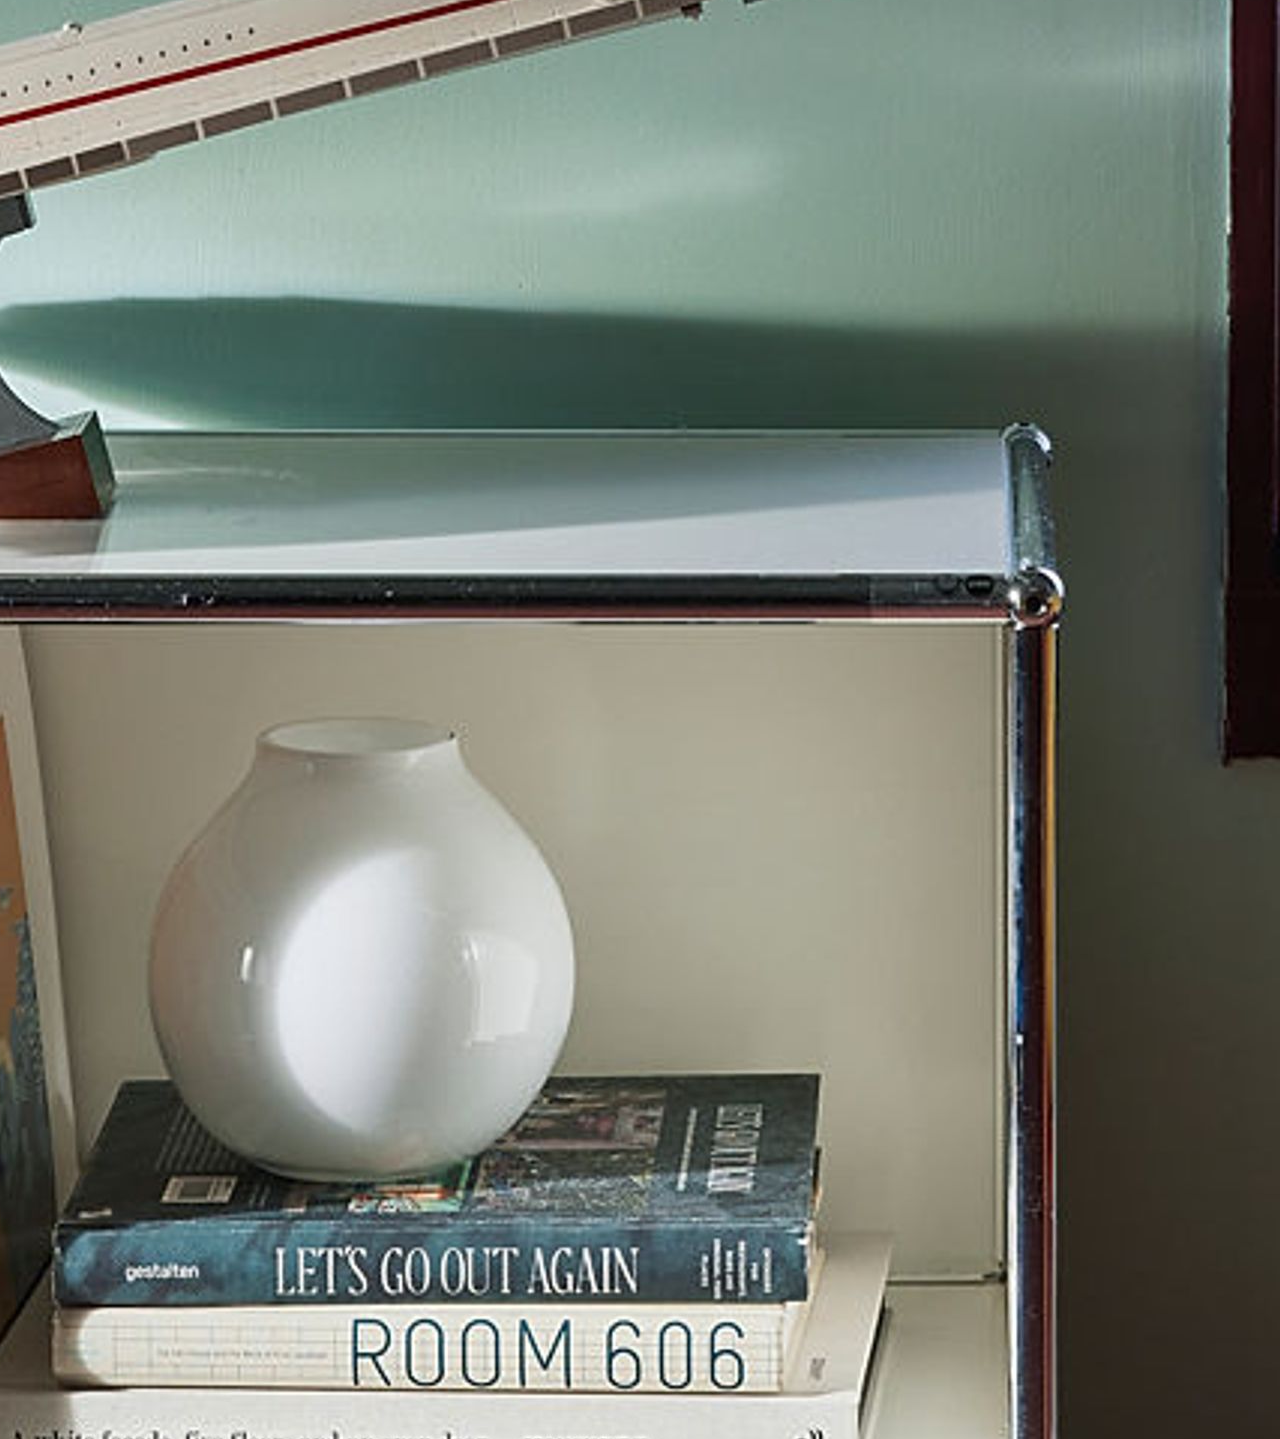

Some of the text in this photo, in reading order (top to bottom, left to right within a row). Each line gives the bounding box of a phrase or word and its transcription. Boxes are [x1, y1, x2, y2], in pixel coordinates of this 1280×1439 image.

[125, 1263, 200, 1282] gestalten
[380, 1247, 431, 1295] GO
[440, 1246, 520, 1294] OUT
[527, 1246, 639, 1295] AGAIN
[352, 1318, 746, 1390] ROOM 606
